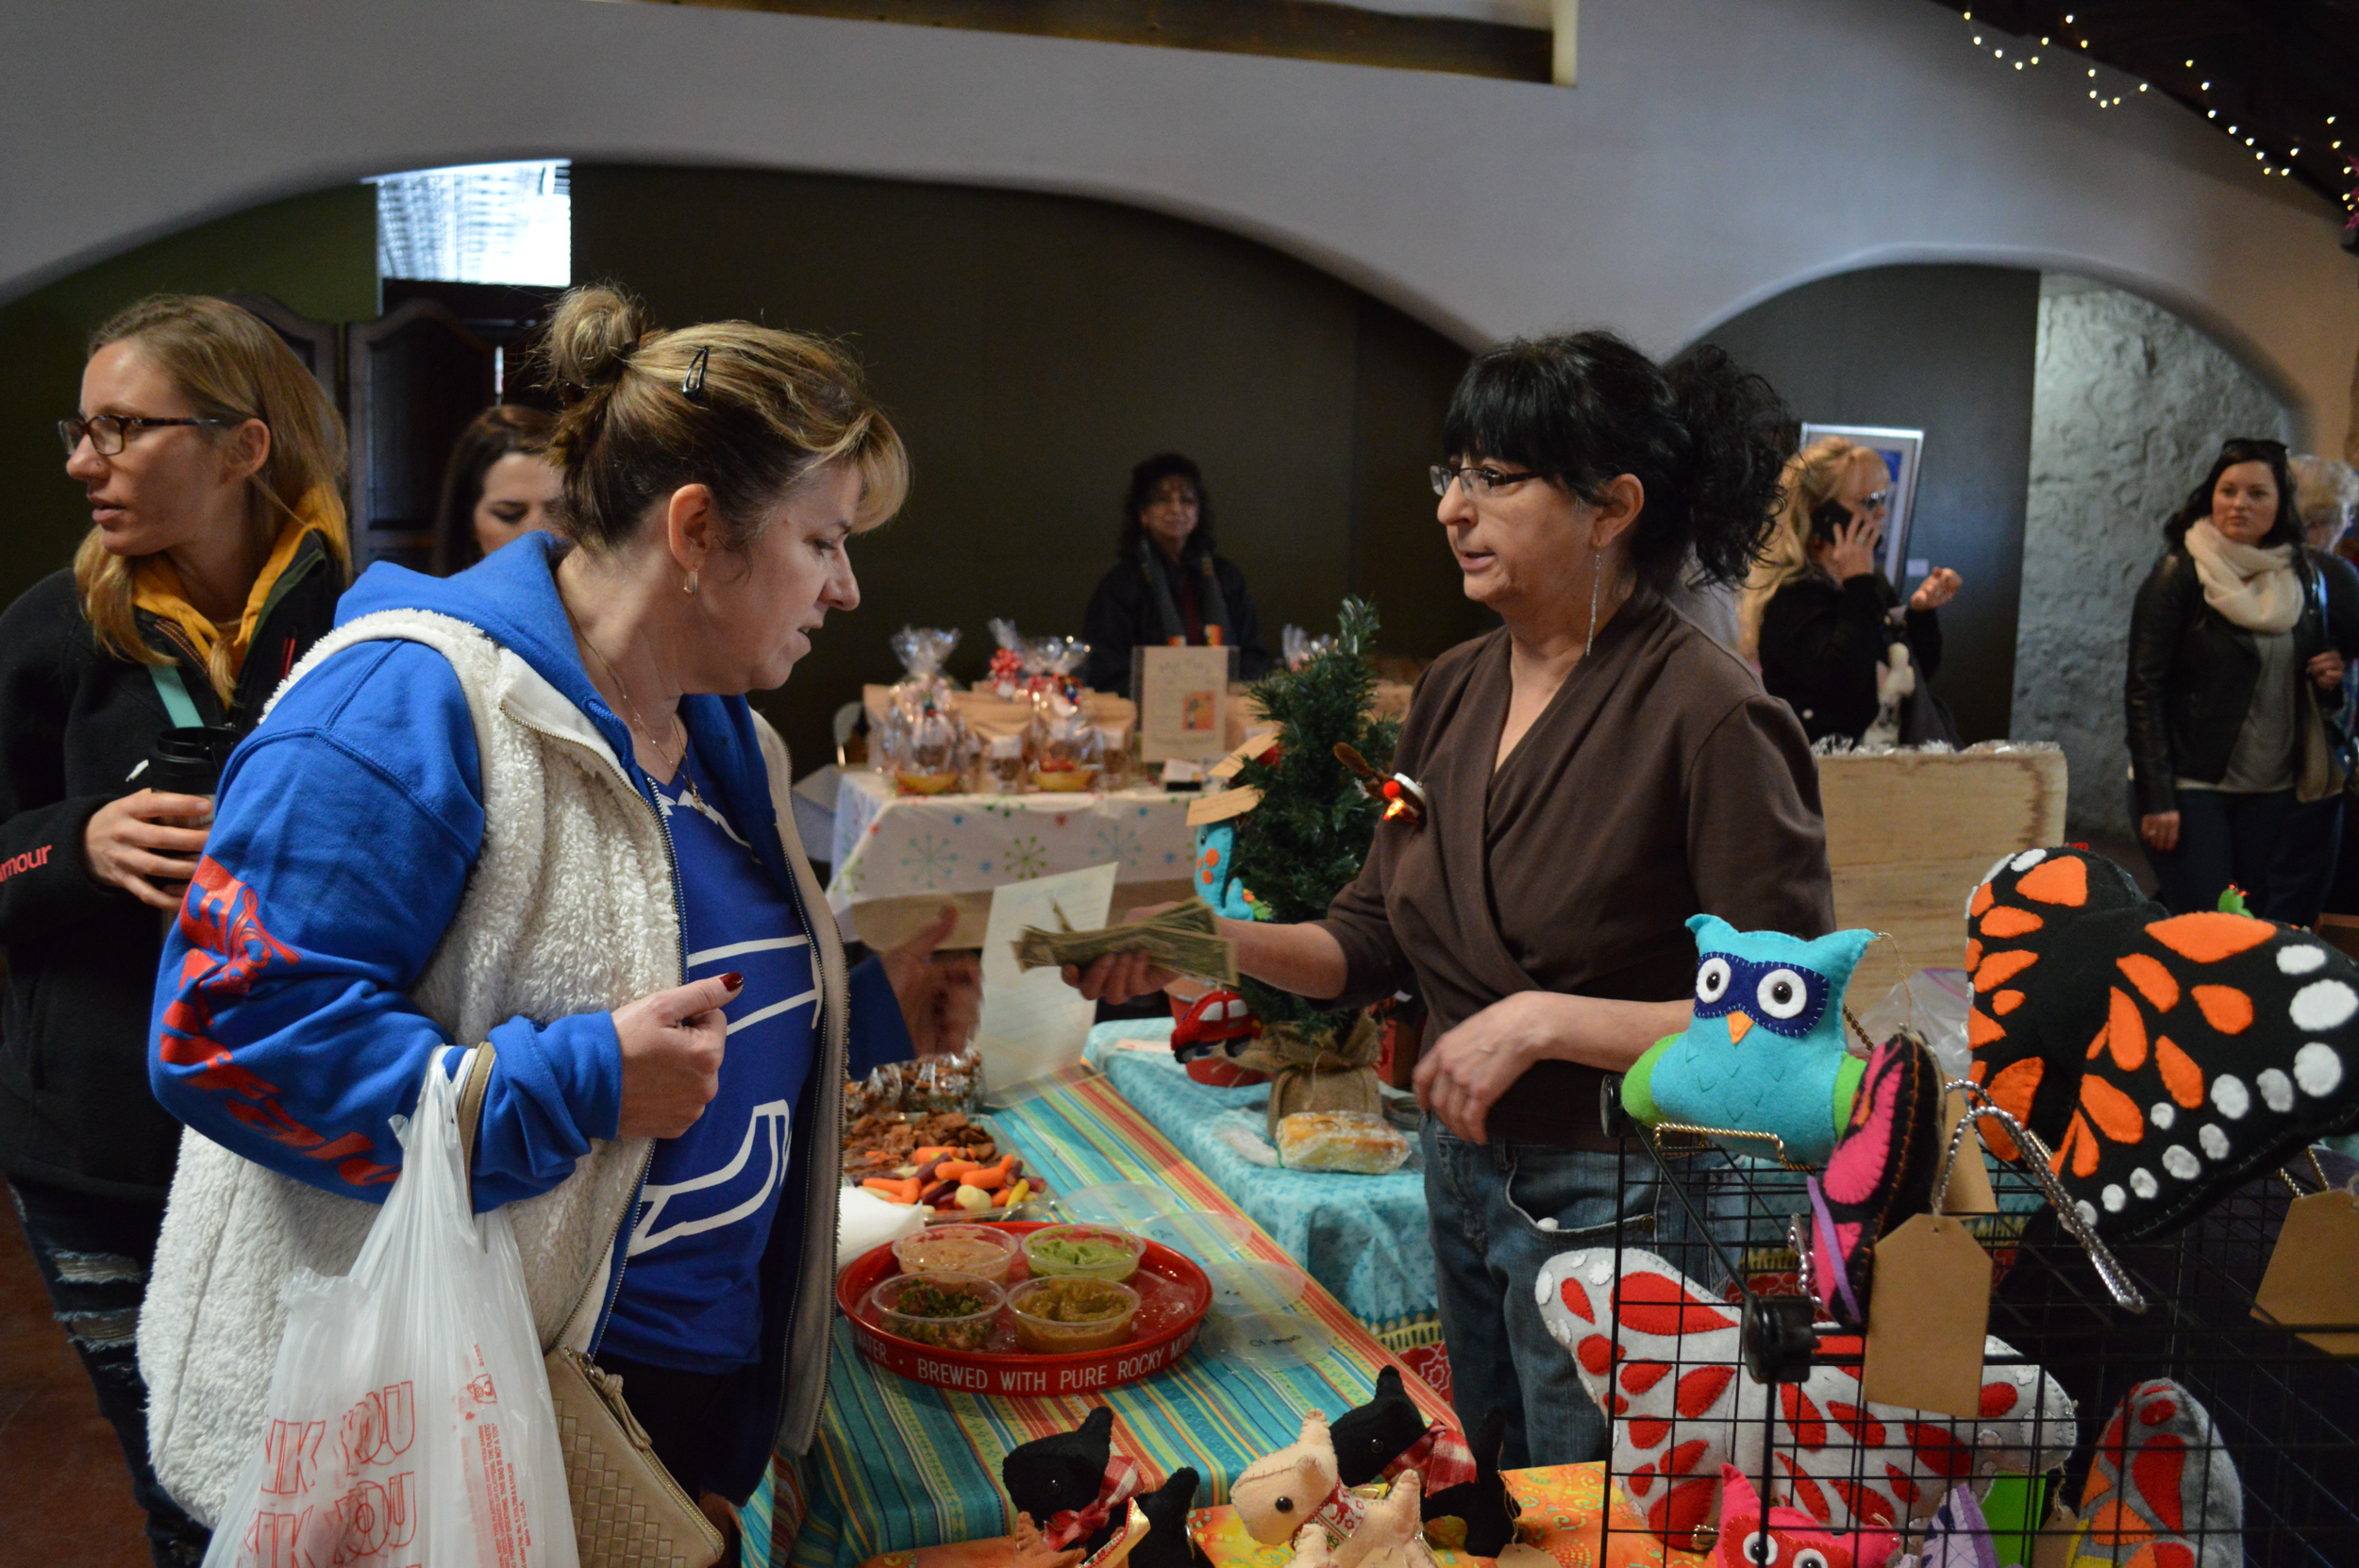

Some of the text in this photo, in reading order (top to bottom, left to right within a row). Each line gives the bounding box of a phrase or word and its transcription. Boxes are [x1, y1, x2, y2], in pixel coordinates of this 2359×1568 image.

[916, 1358, 989, 1391] BREWED
[999, 1370, 1047, 1392] WITH
[1060, 1364, 1109, 1391] PURE
[1117, 1346, 1166, 1380] ROCKY
